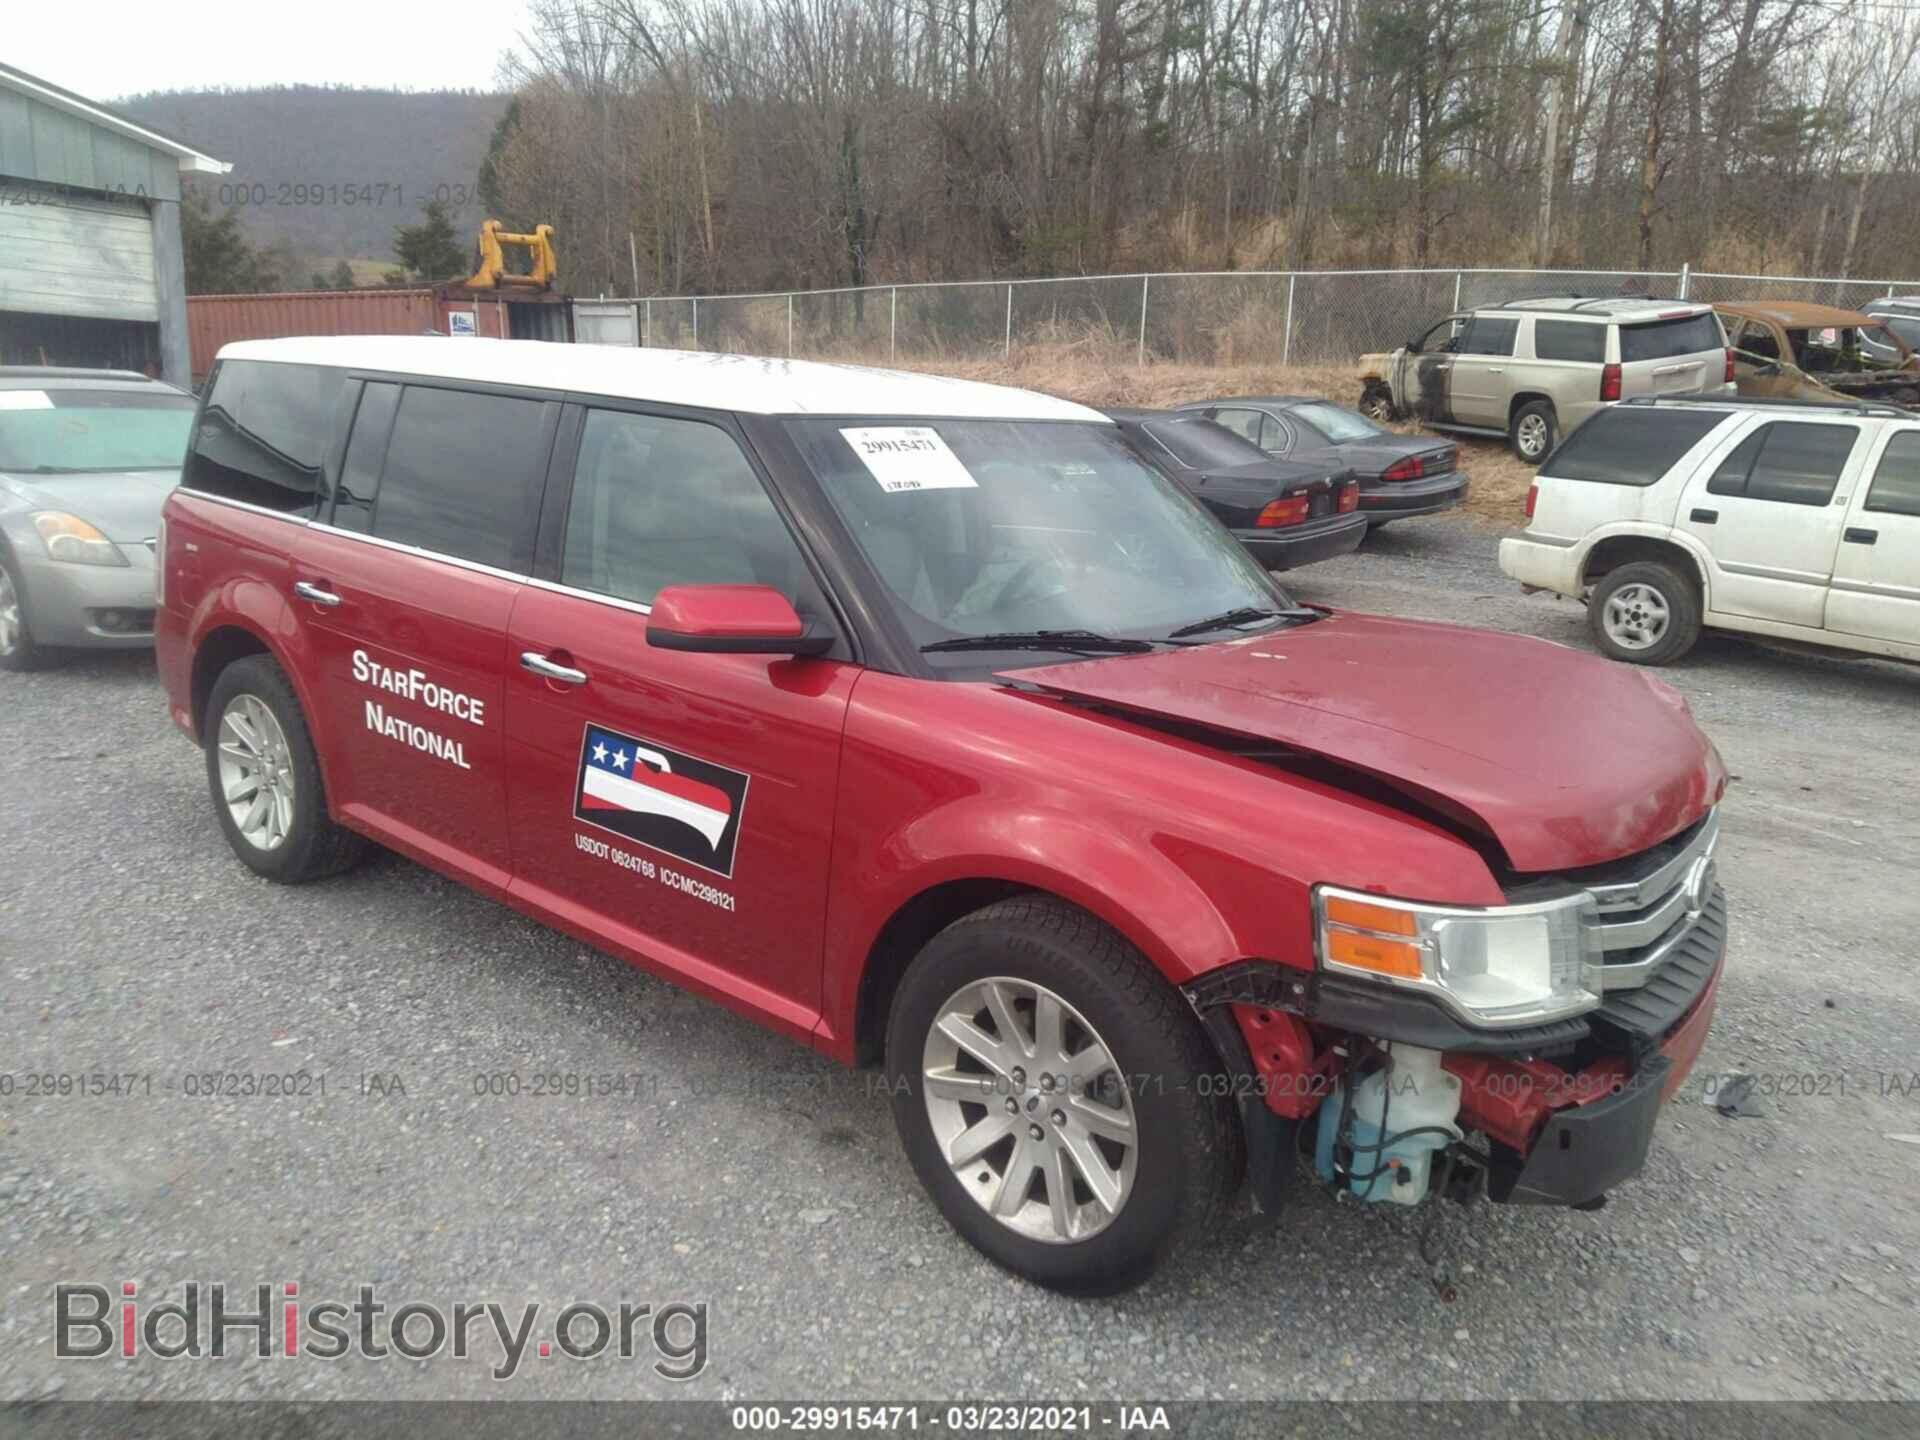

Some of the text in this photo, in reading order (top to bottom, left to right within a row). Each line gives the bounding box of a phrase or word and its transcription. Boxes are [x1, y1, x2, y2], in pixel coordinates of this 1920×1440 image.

[861, 438, 937, 454] 29915471
[575, 833, 610, 860] USDOT
[611, 848, 656, 879] 0624768
